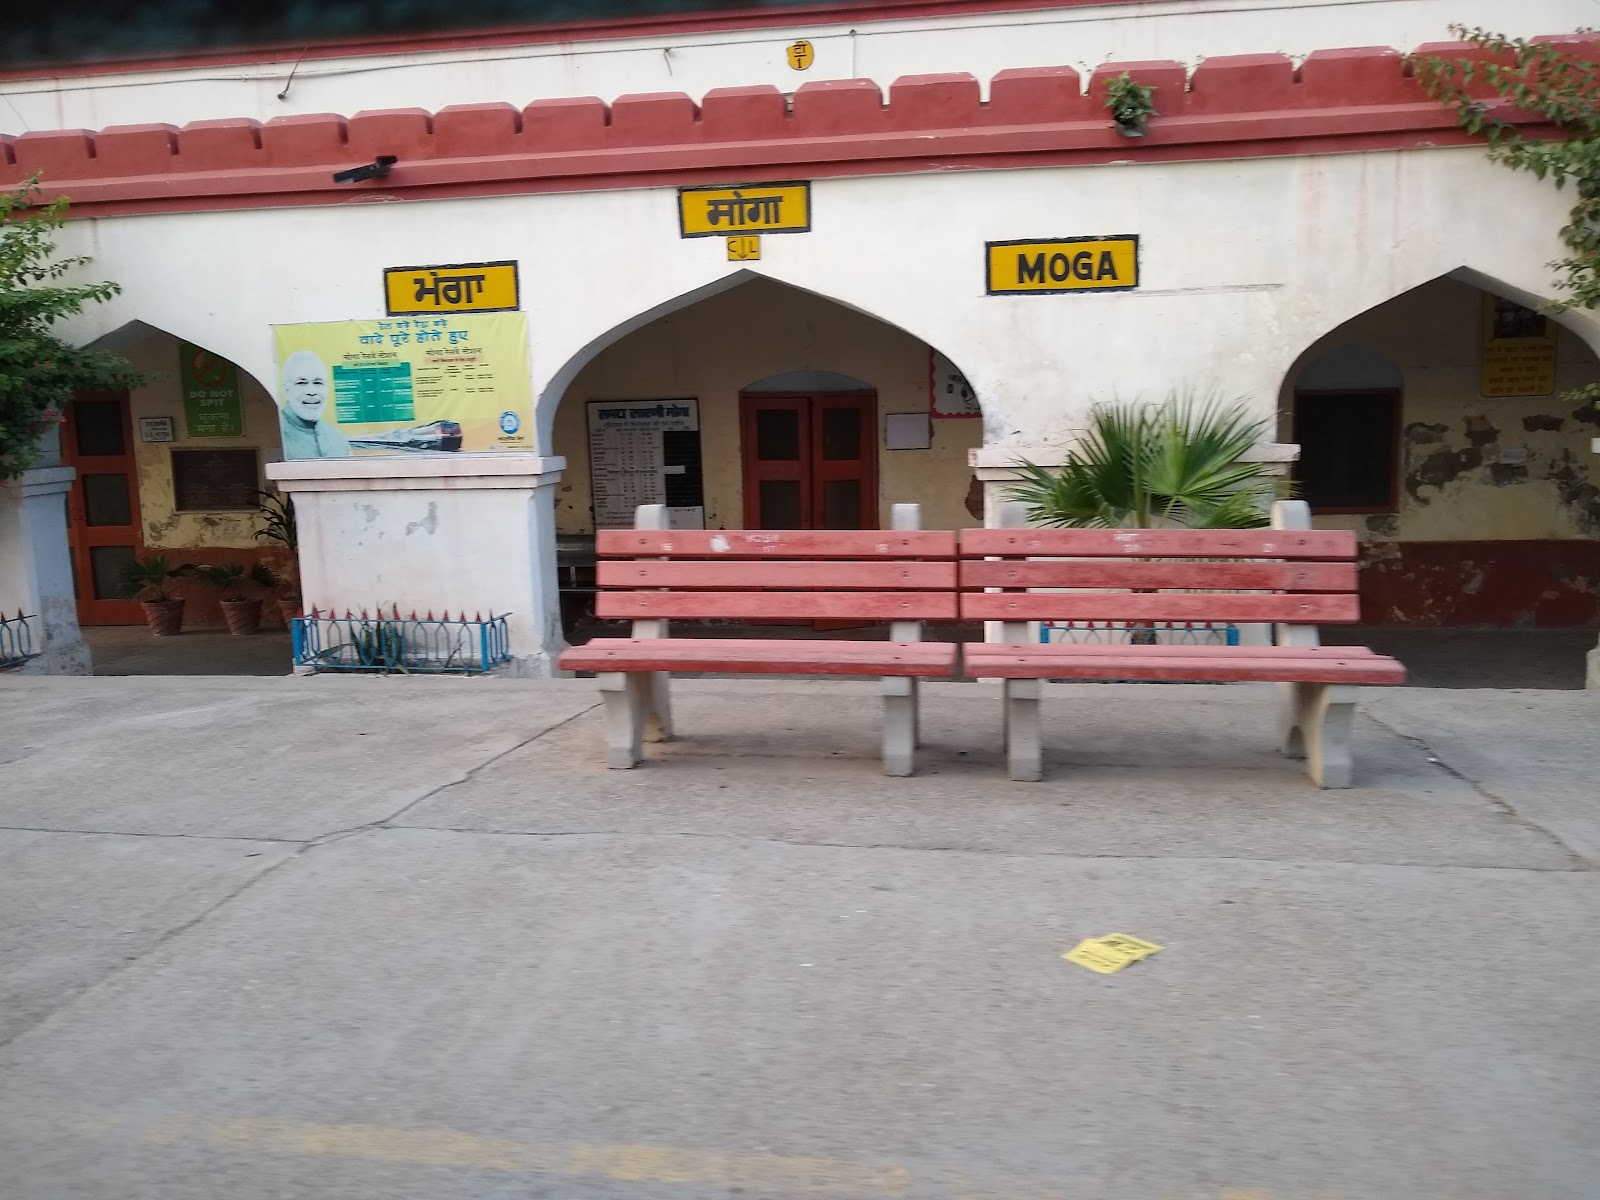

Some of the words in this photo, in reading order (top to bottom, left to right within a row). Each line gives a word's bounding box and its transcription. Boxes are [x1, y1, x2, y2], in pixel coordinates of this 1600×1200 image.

[706, 190, 784, 226] मोगा
[728, 240, 737, 253] C
[749, 240, 757, 253] L
[1017, 251, 1118, 284] MOGA
[359, 332, 384, 345] वादे
[390, 331, 410, 347] पूरे
[416, 329, 442, 344] होते
[448, 329, 469, 344] हुए
[210, 389, 234, 398] NOT
